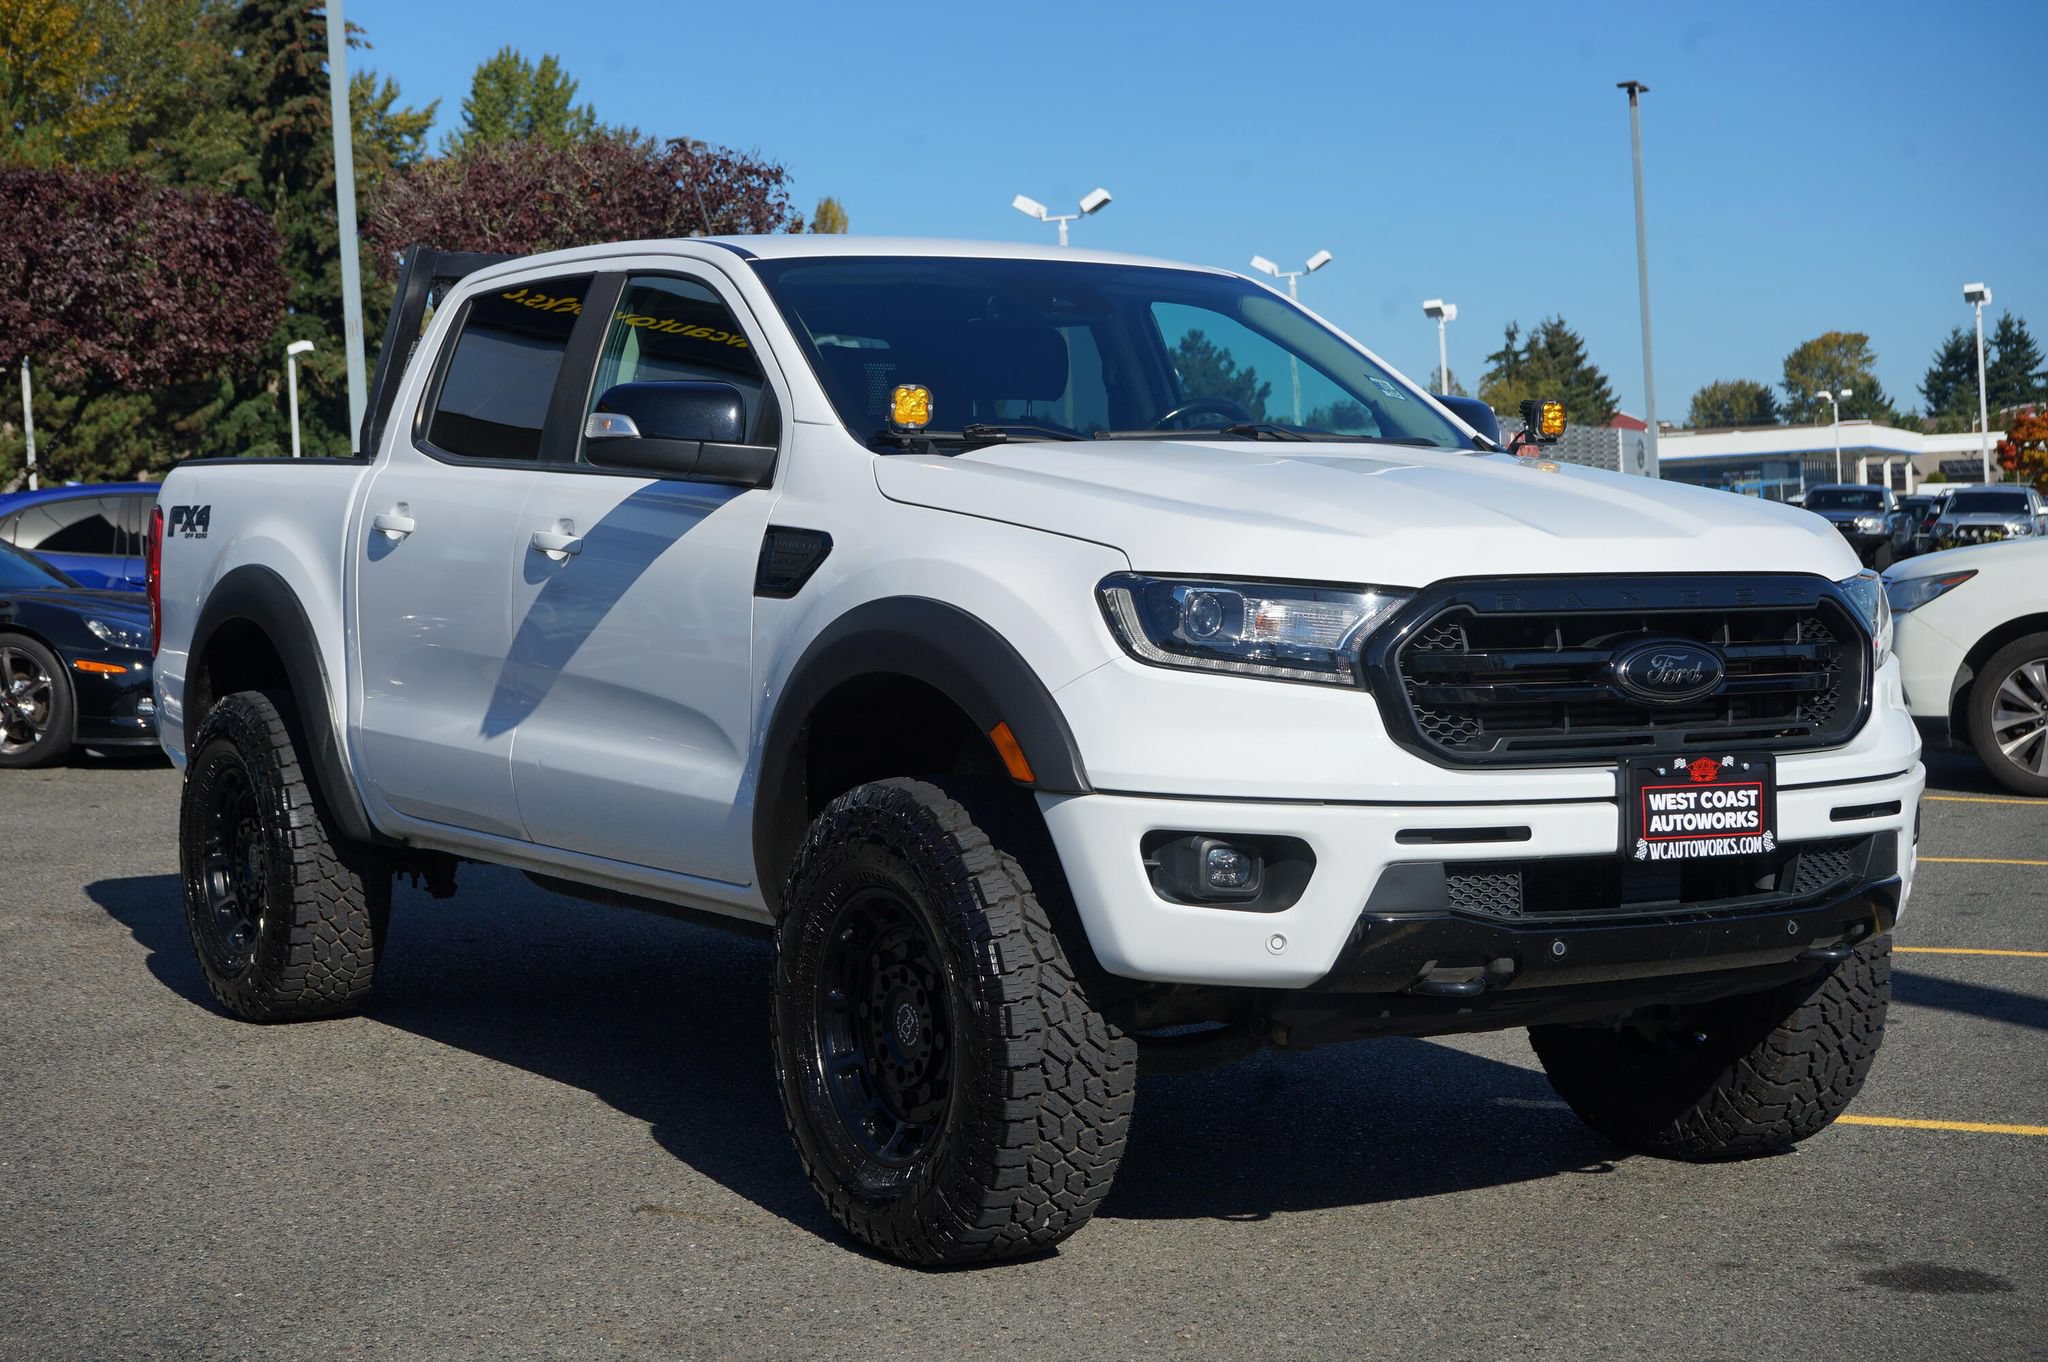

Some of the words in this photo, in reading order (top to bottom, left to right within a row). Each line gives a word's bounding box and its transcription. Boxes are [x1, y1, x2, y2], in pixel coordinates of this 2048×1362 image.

[168, 505, 211, 537] FX4
[1647, 654, 1704, 684] Ford
[1649, 792, 1697, 810] WEST
[1700, 790, 1758, 808] COAST
[1650, 811, 1759, 832] AUTOWORKS
[1649, 836, 1762, 860] WCAUTOWORKS.COM
